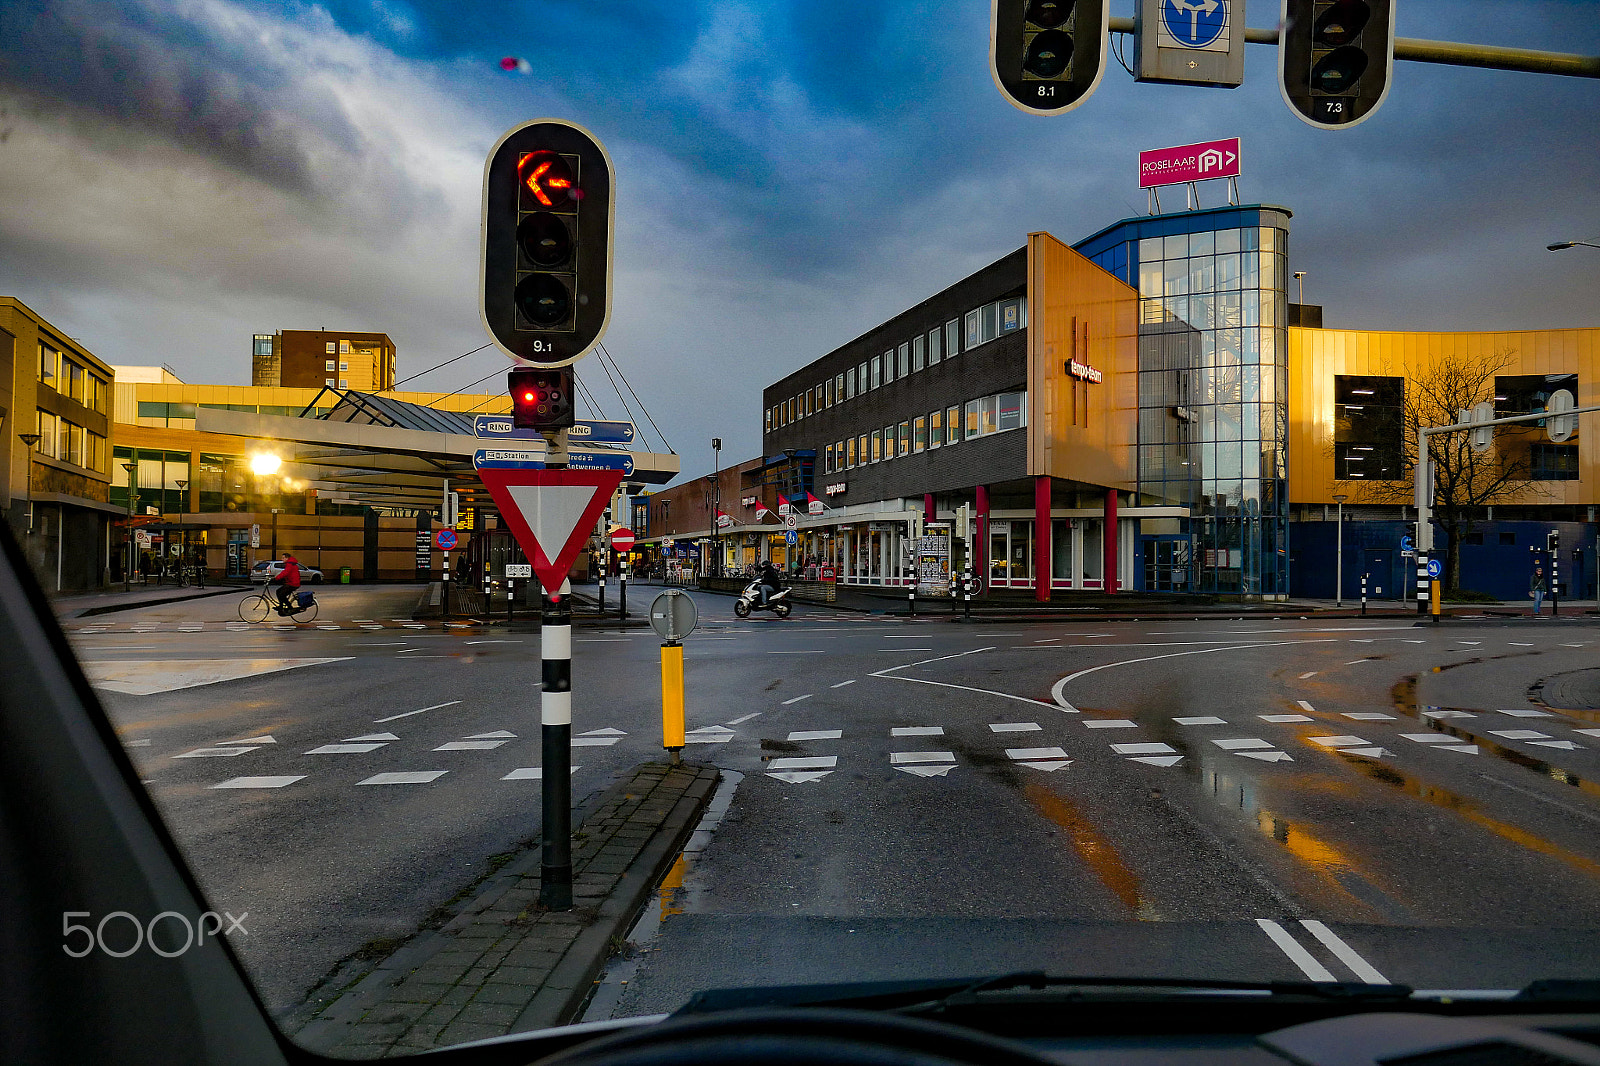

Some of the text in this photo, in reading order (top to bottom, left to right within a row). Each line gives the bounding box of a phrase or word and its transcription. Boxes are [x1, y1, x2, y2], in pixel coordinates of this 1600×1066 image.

[1038, 86, 1054, 96] 8.1
[1326, 102, 1342, 112] 7.3
[1142, 157, 1196, 172] ROSELAAR
[533, 340, 552, 352] 9.1
[489, 423, 510, 431] RING
